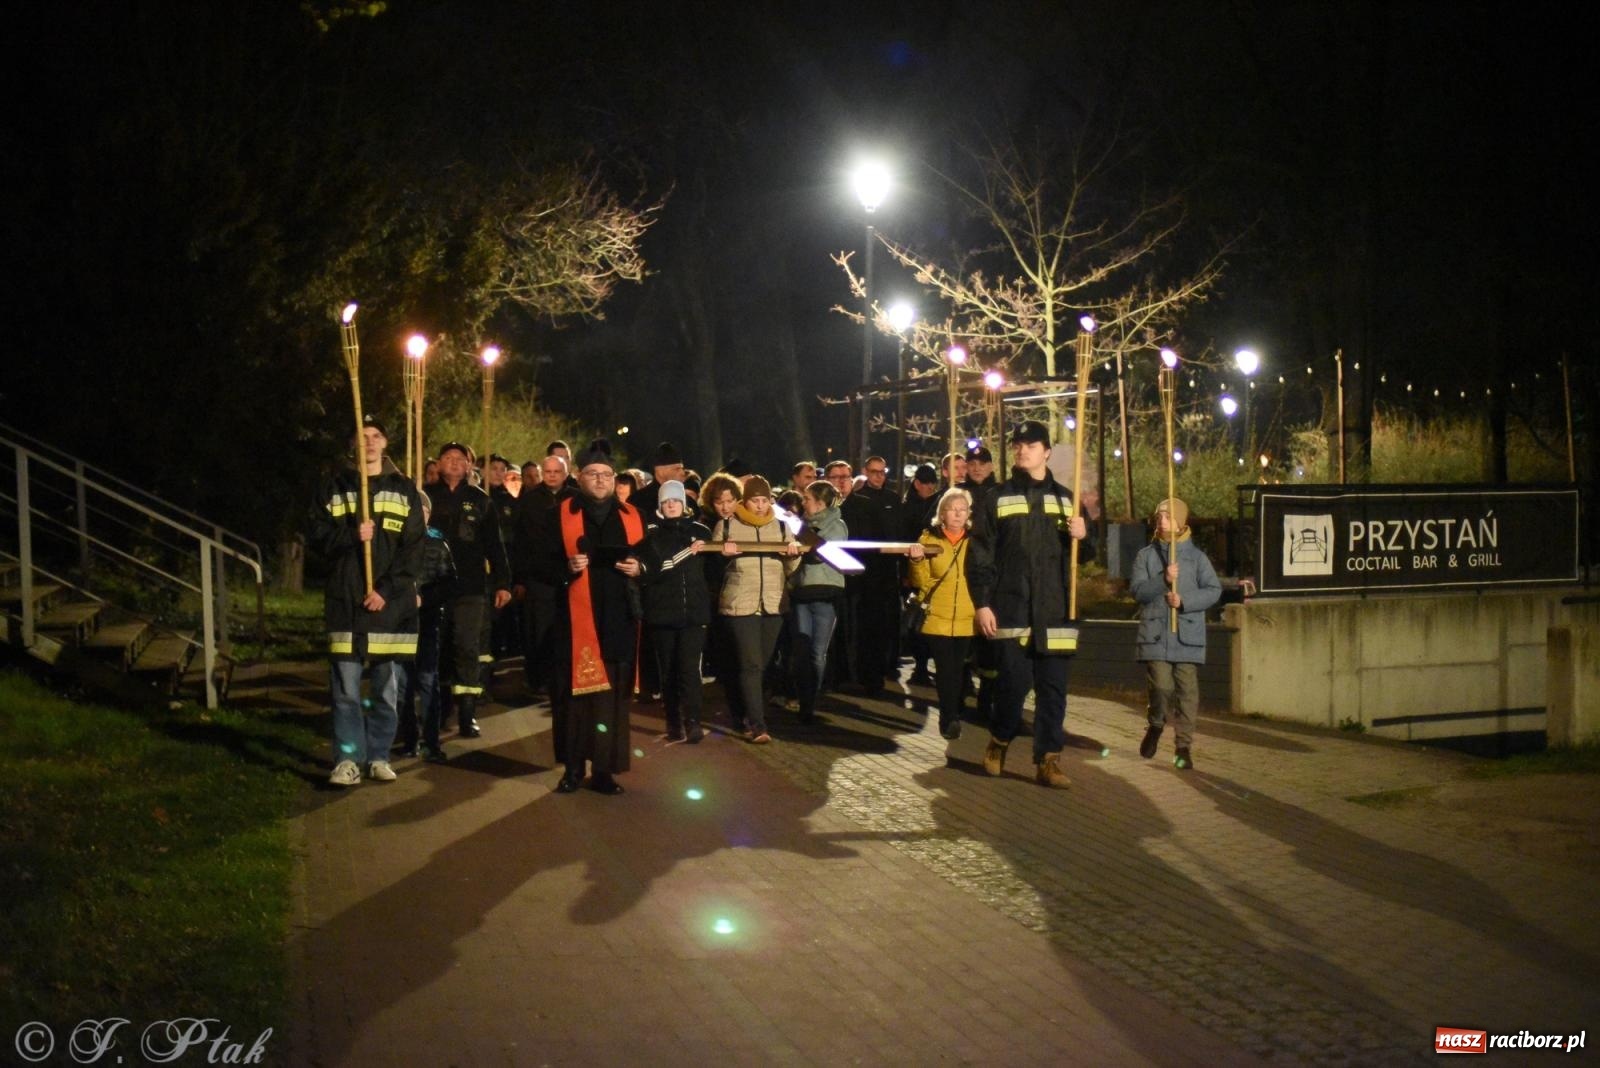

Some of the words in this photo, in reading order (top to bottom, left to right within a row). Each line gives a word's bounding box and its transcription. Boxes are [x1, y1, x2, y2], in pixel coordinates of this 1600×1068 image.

[1349, 510, 1498, 551] PRZYSTAŃ
[1346, 556, 1401, 571] COCTAIL
[1413, 554, 1438, 568] BAR
[1448, 553, 1458, 568] &
[1468, 553, 1502, 567] GRILL
